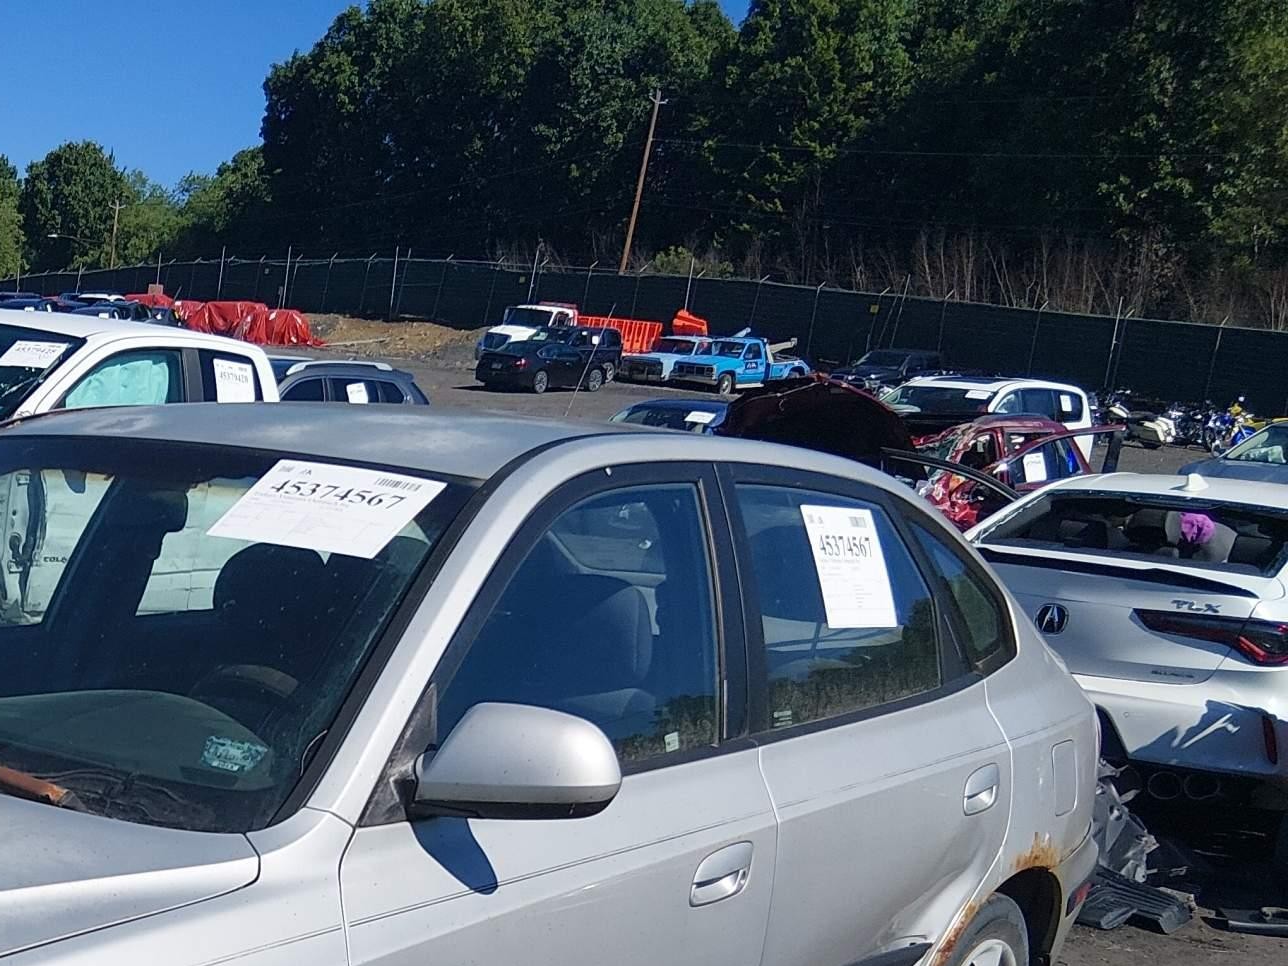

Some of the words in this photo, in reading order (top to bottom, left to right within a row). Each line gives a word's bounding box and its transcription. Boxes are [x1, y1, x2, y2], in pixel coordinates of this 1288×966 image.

[270, 478, 407, 510] 45374567
[819, 535, 873, 558] 45374567
[1170, 599, 1222, 614] TLX
